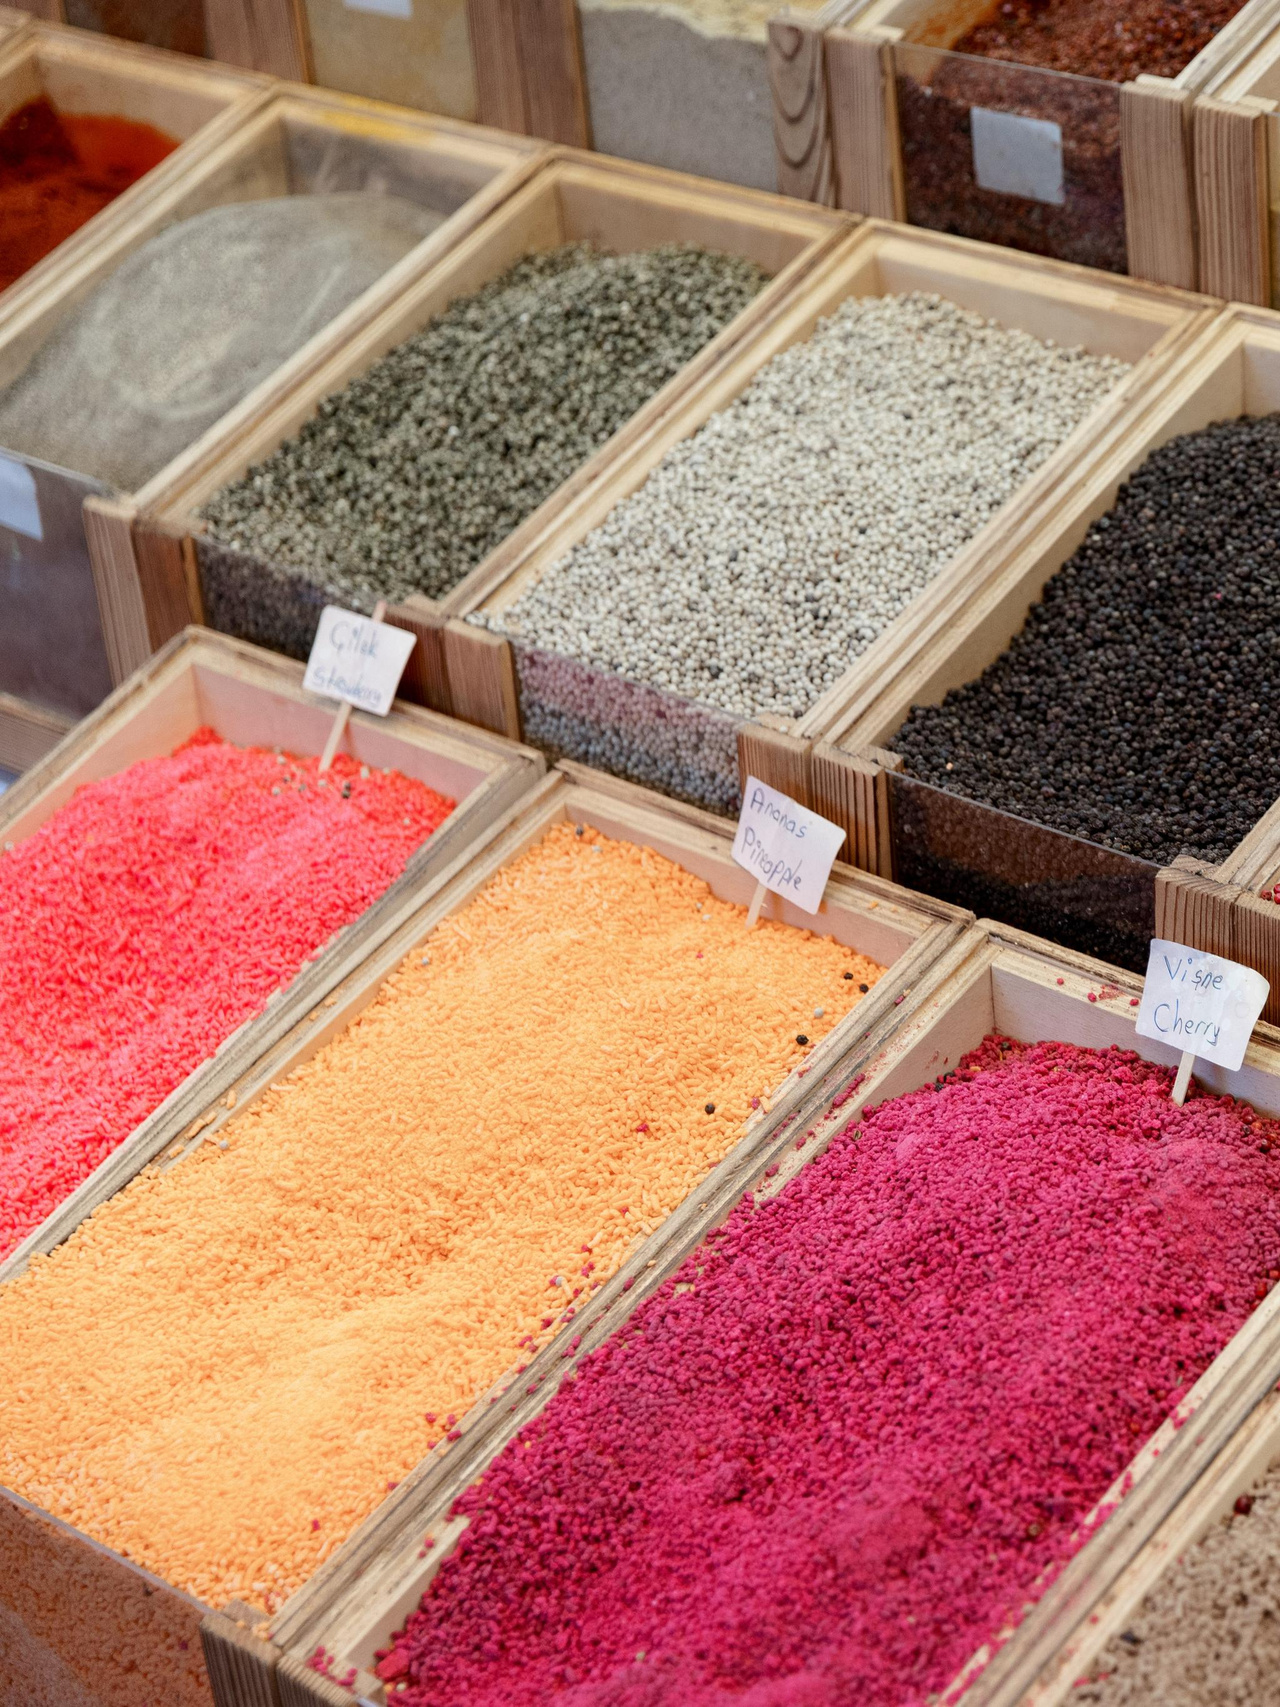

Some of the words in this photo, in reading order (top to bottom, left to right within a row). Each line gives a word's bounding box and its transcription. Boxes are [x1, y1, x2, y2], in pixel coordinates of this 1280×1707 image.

[750, 787, 808, 839] Ananas
[1163, 955, 1224, 991] Vişne
[1153, 998, 1221, 1047] Cherry
